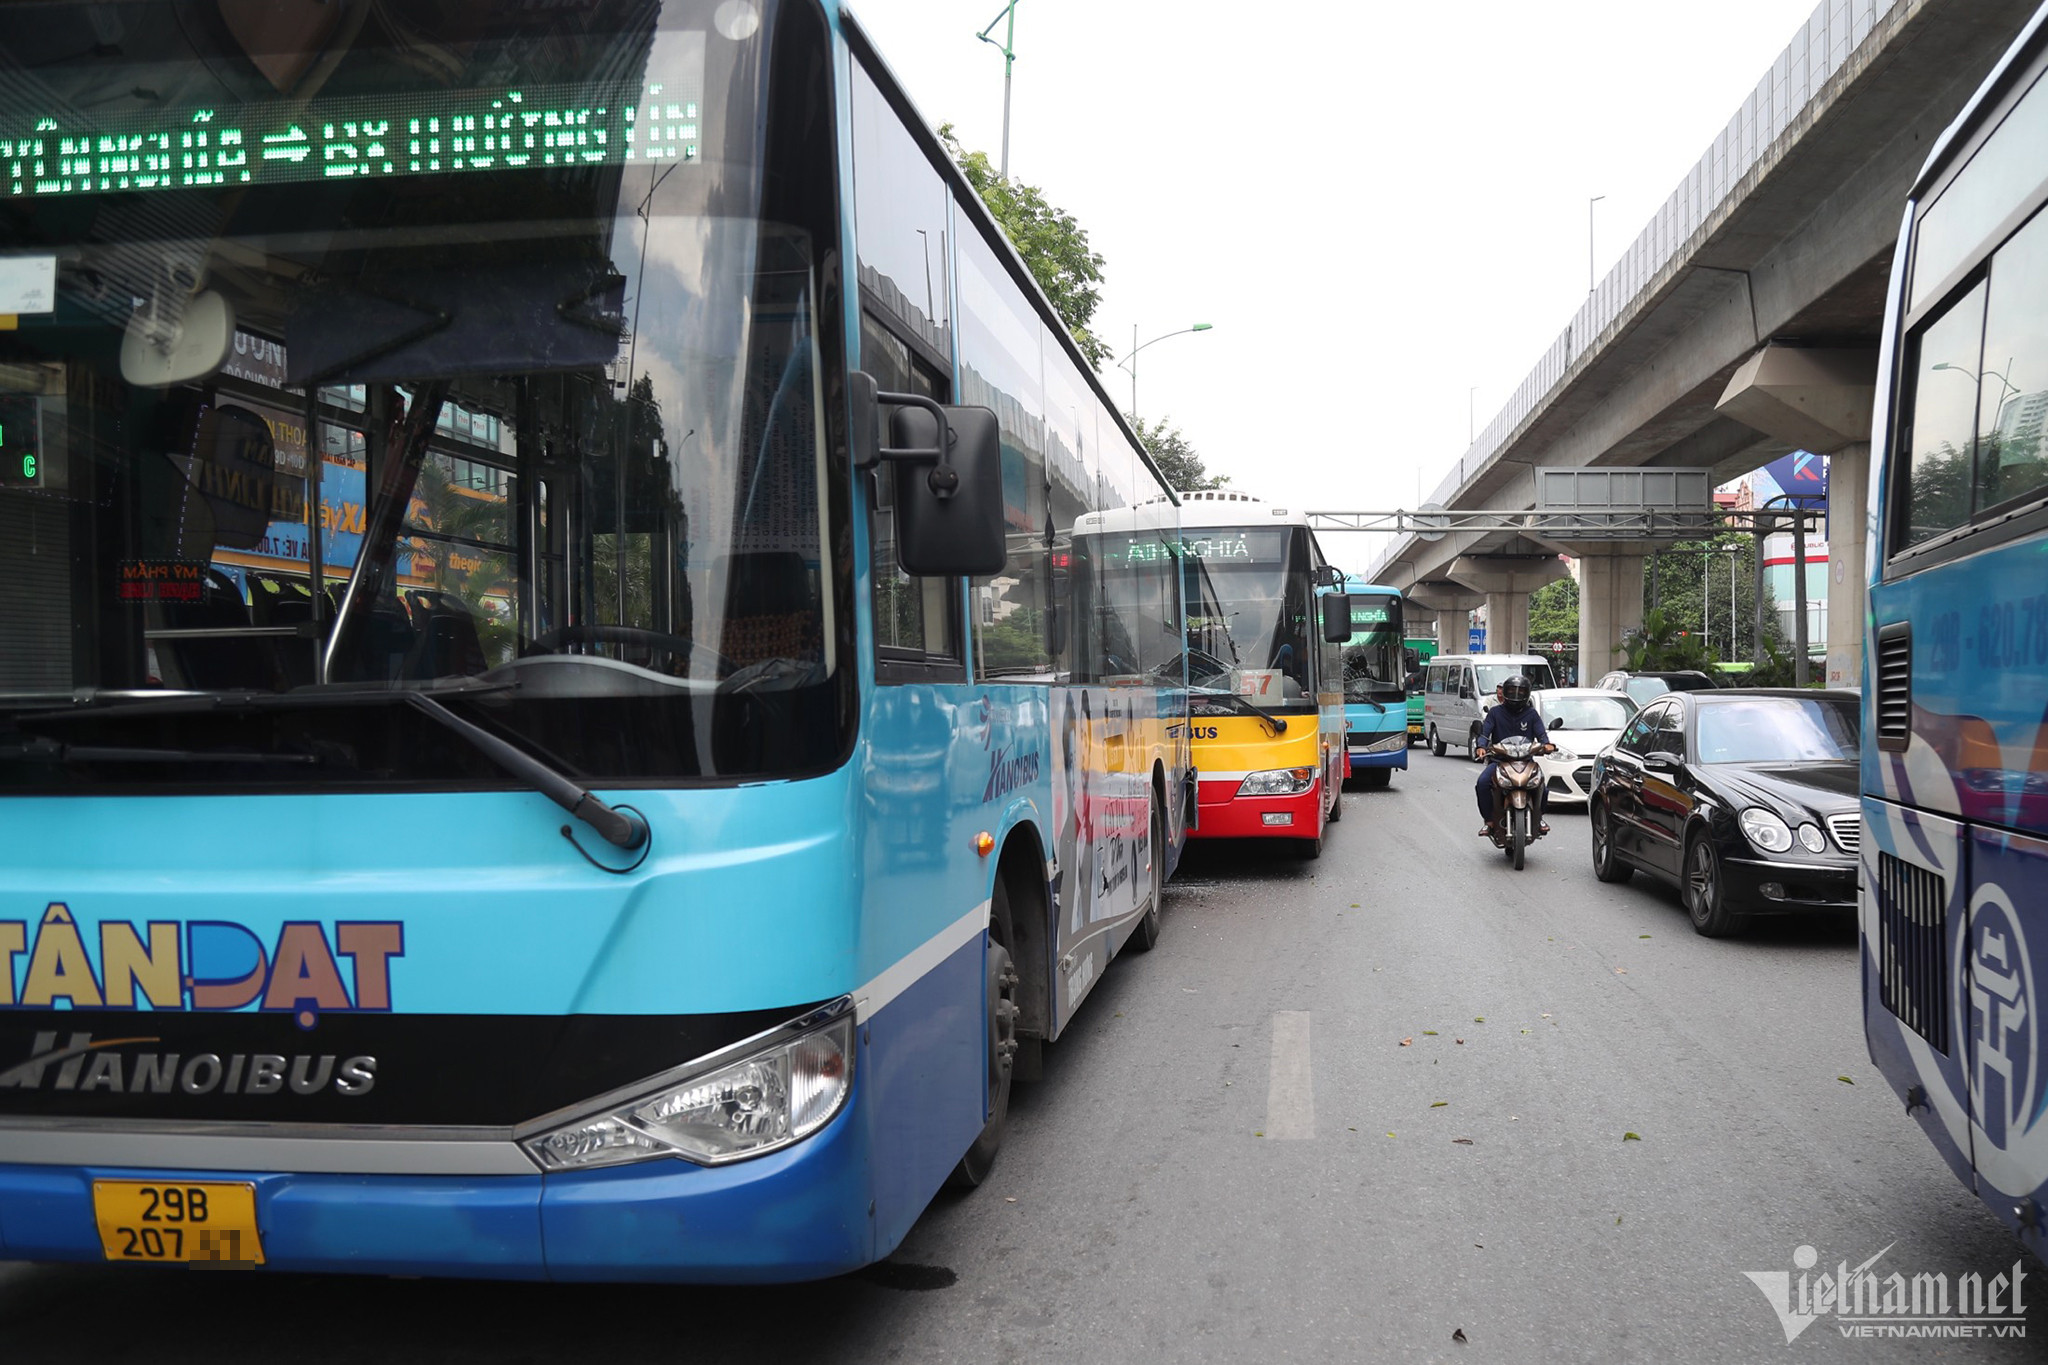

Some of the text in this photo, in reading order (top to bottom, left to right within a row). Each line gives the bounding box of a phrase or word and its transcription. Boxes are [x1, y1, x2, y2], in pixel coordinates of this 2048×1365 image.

[1240, 674, 1272, 695] 57
[983, 746, 1039, 803] HANOIBUS
[0, 1031, 378, 1096] HANOIBUS
[139, 1187, 209, 1224] 29B
